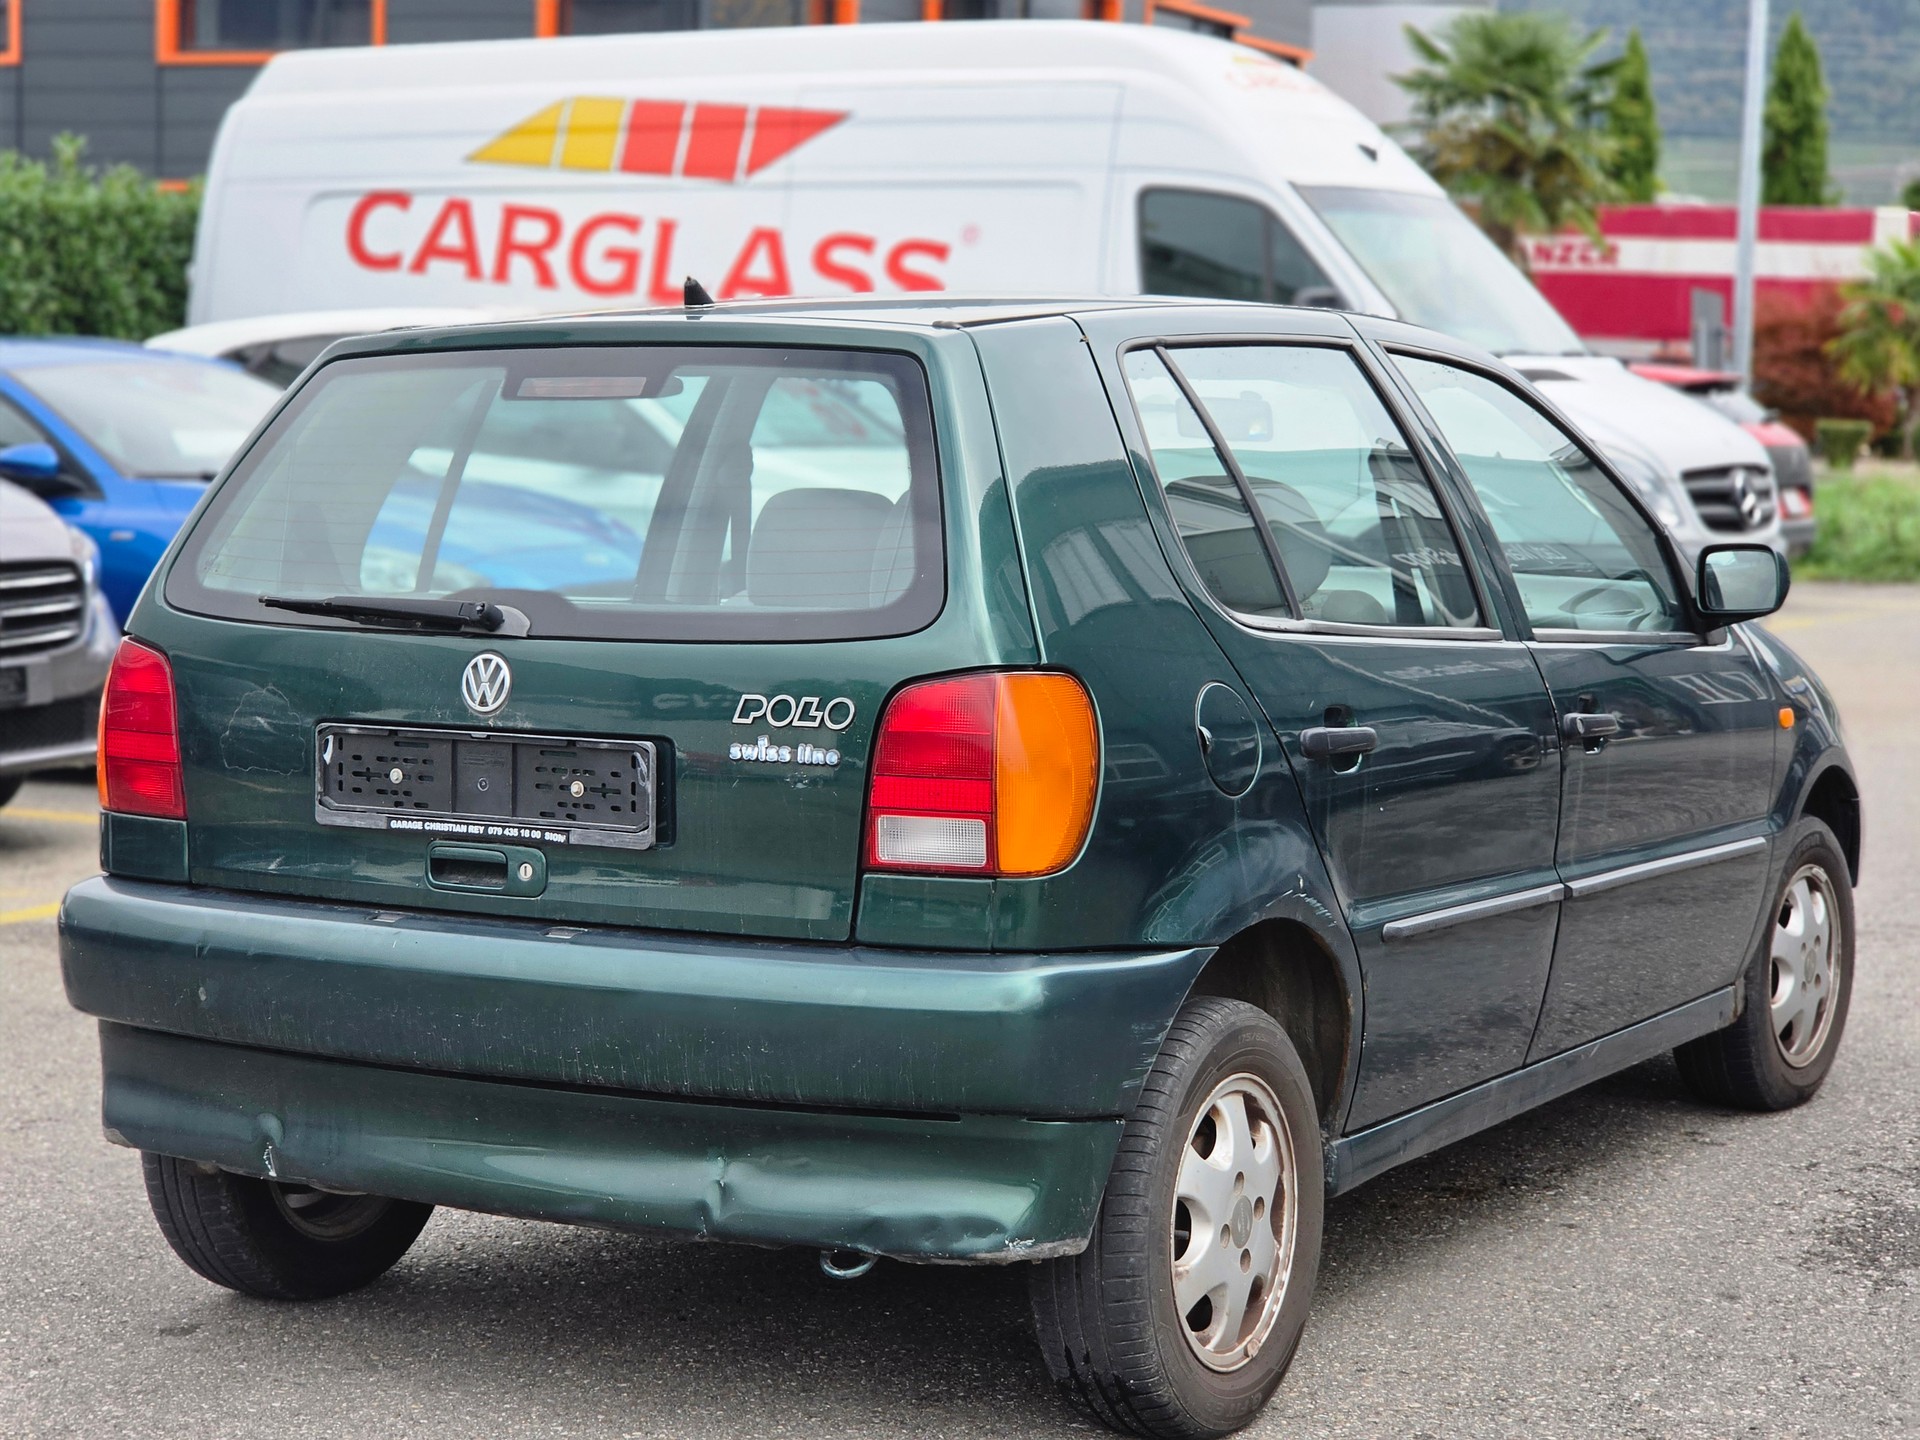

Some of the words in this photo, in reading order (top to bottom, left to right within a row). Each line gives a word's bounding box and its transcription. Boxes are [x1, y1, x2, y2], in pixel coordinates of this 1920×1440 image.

[345, 189, 952, 302] CARGLASS
[732, 694, 855, 730] POLO
[729, 735, 792, 762] swiss
[797, 743, 841, 765] line
[390, 819, 423, 830] GARAGE
[424, 821, 467, 833] CHRISTIAN
[468, 824, 485, 834] REY
[488, 826, 502, 836] 079
[503, 827, 519, 837] 435
[520, 828, 531, 838] 18
[531, 830, 542, 839] 00
